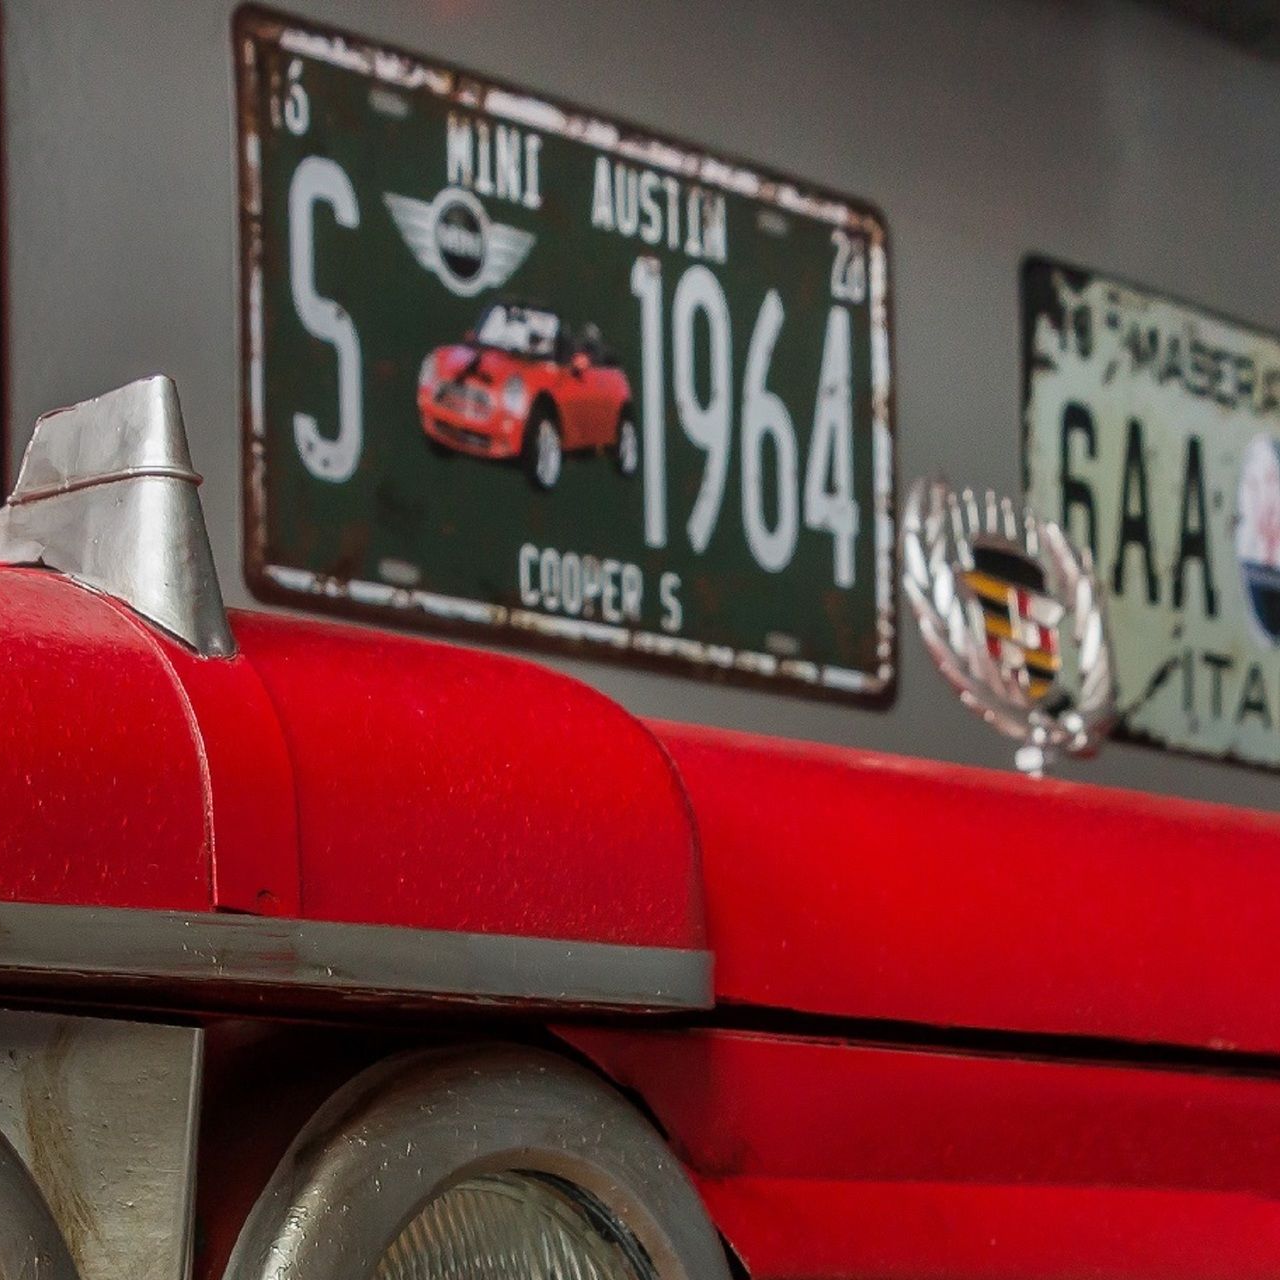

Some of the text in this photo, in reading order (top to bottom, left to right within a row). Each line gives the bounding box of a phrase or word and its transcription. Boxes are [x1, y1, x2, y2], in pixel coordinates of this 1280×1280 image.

[446, 110, 728, 266] MINI AUSTIN
[287, 154, 860, 590] S 1964
[519, 542, 683, 633] COOPER S
[1061, 400, 1218, 620] 6AA
